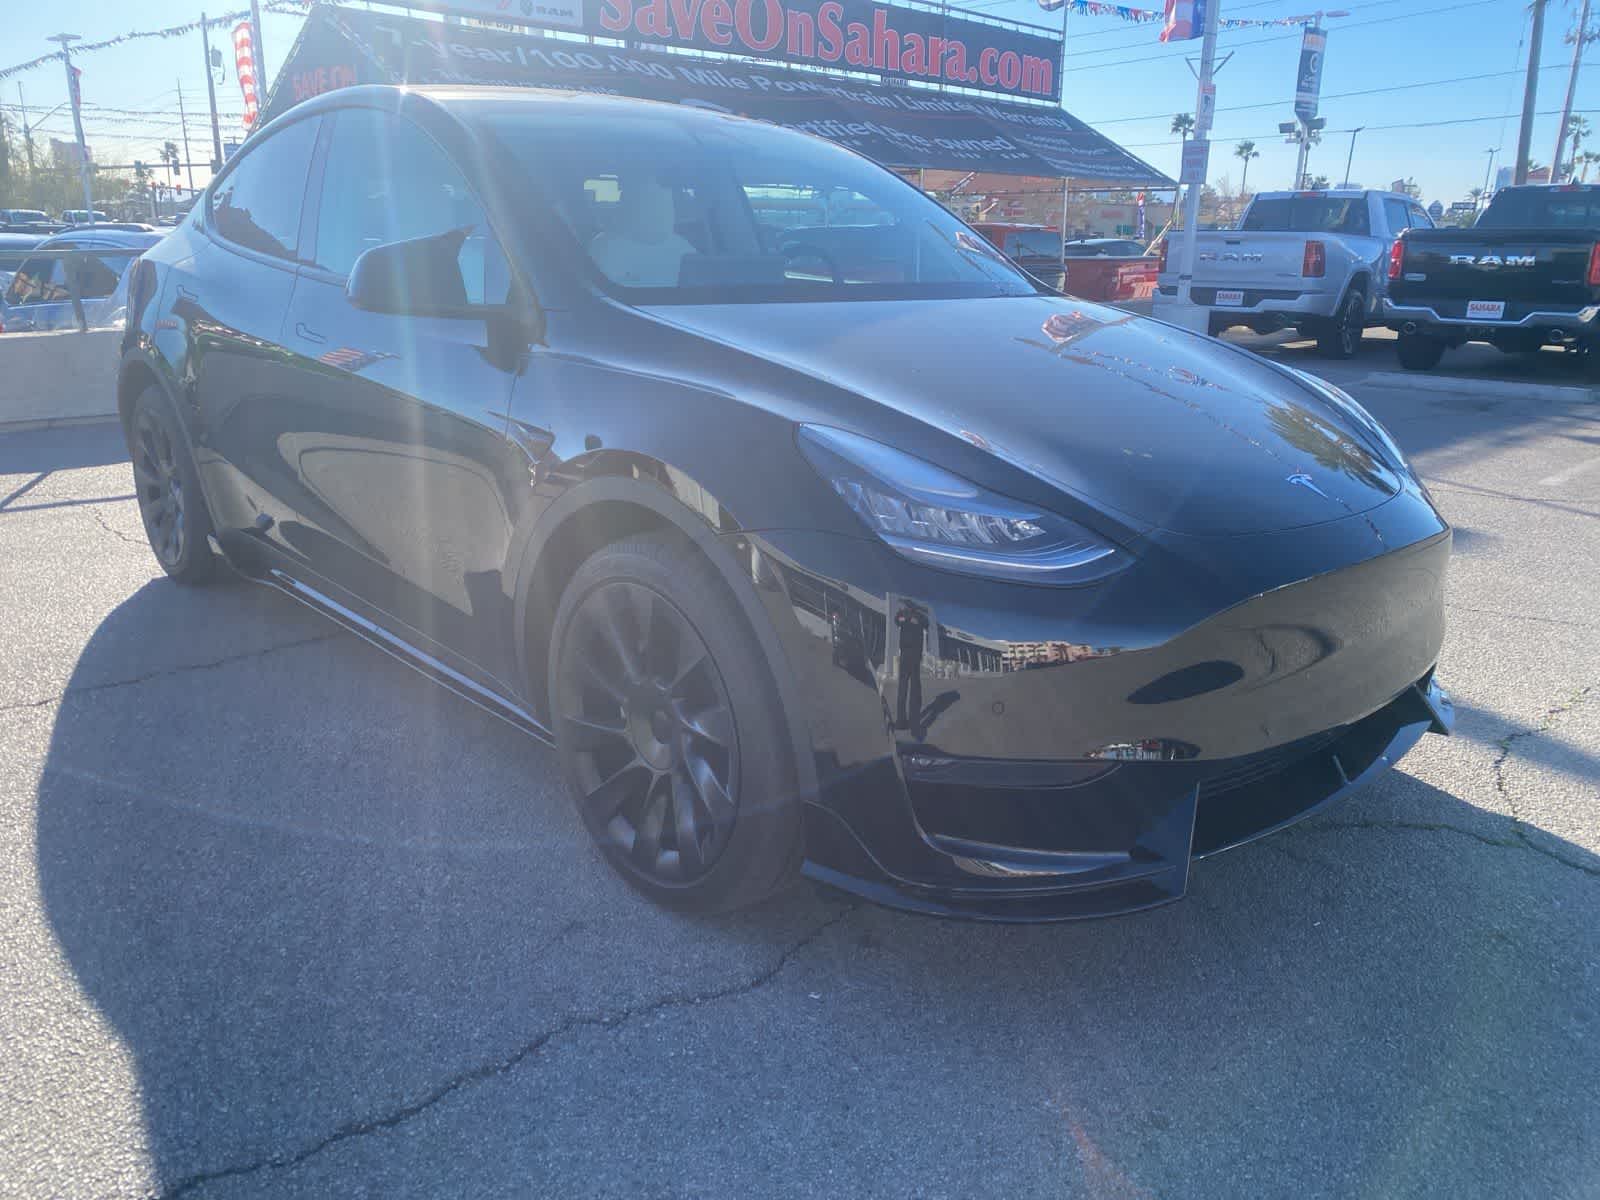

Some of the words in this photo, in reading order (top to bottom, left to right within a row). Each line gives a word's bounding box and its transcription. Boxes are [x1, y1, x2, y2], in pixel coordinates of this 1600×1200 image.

[600, 0, 1053, 96] SaveOnSahara.com
[677, 66, 750, 90] Mile
[982, 106, 1073, 131] Warranty
[1200, 252, 1264, 263] RAM
[1449, 255, 1536, 266] RAM
